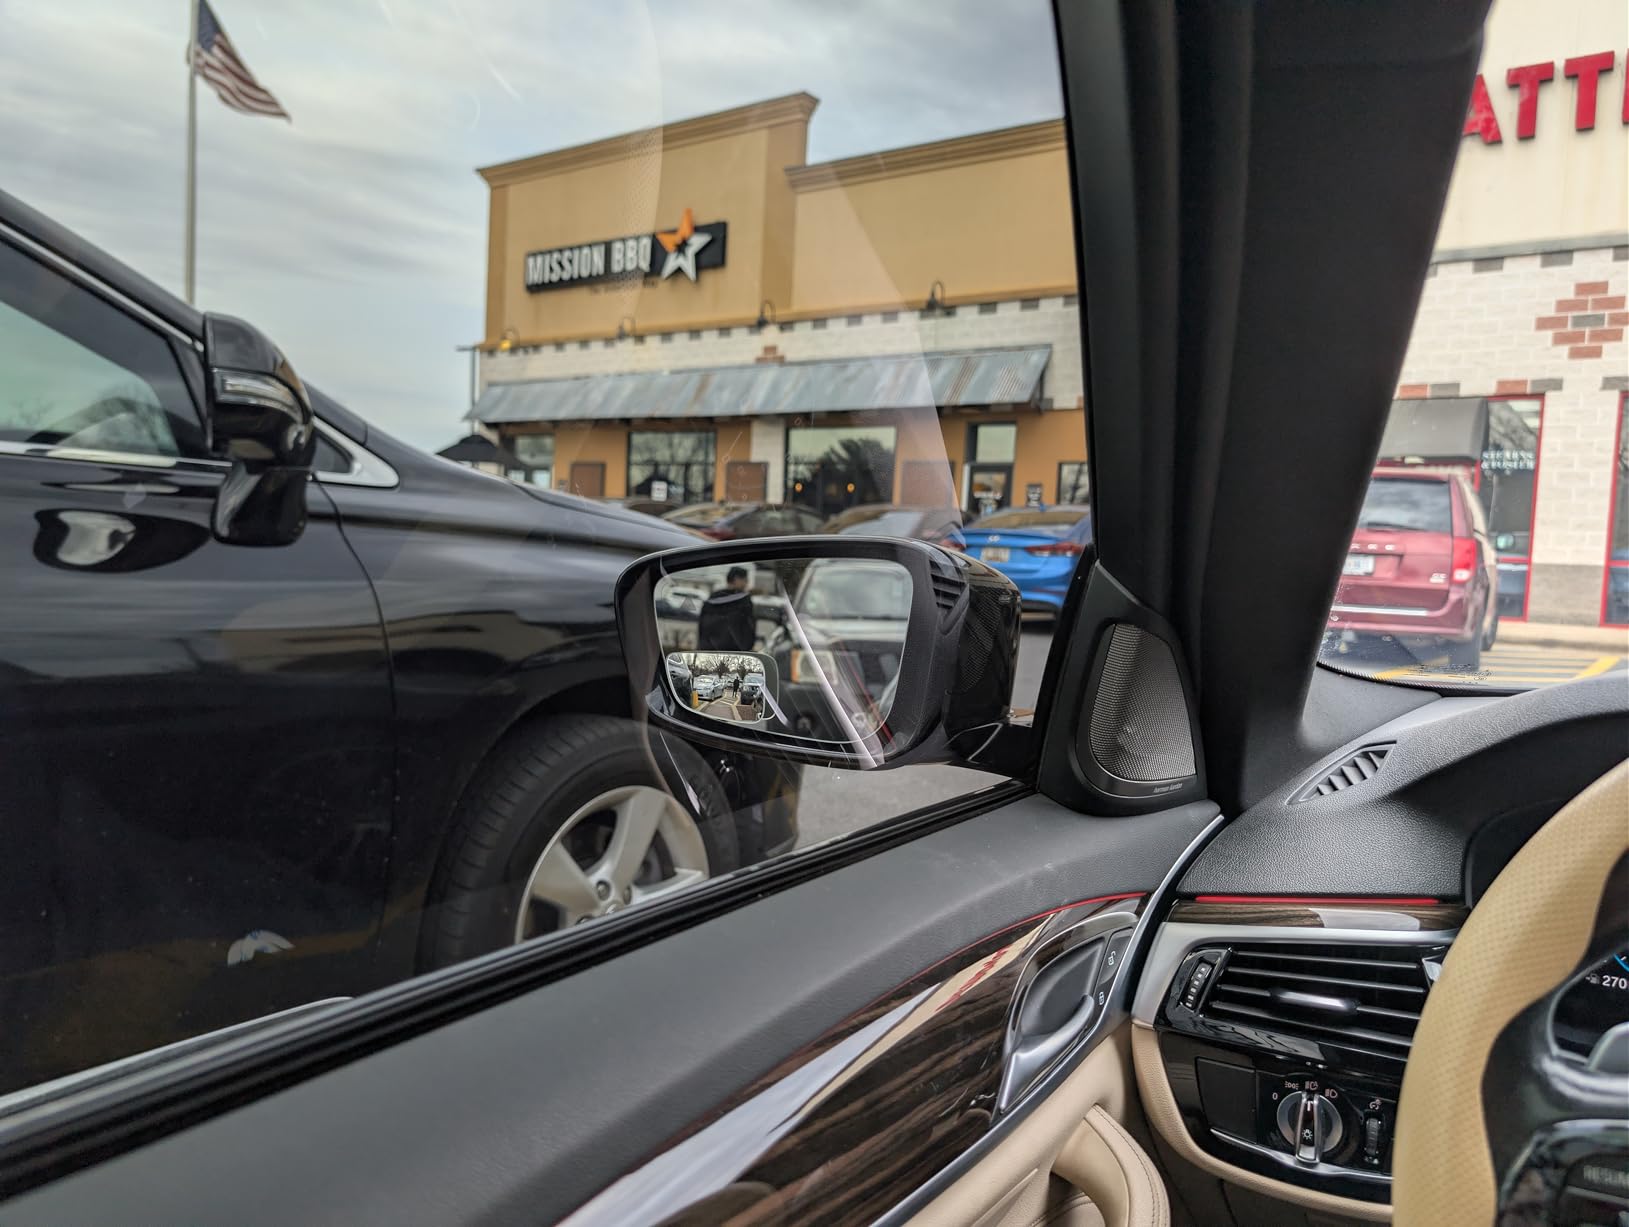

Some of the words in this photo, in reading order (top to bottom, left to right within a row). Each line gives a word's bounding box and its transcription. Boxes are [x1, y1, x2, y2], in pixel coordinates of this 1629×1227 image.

[1463, 48, 1629, 145] ATT
[527, 243, 606, 286] MISSION
[610, 235, 653, 274] BBQ
[1601, 974, 1628, 990] 270
